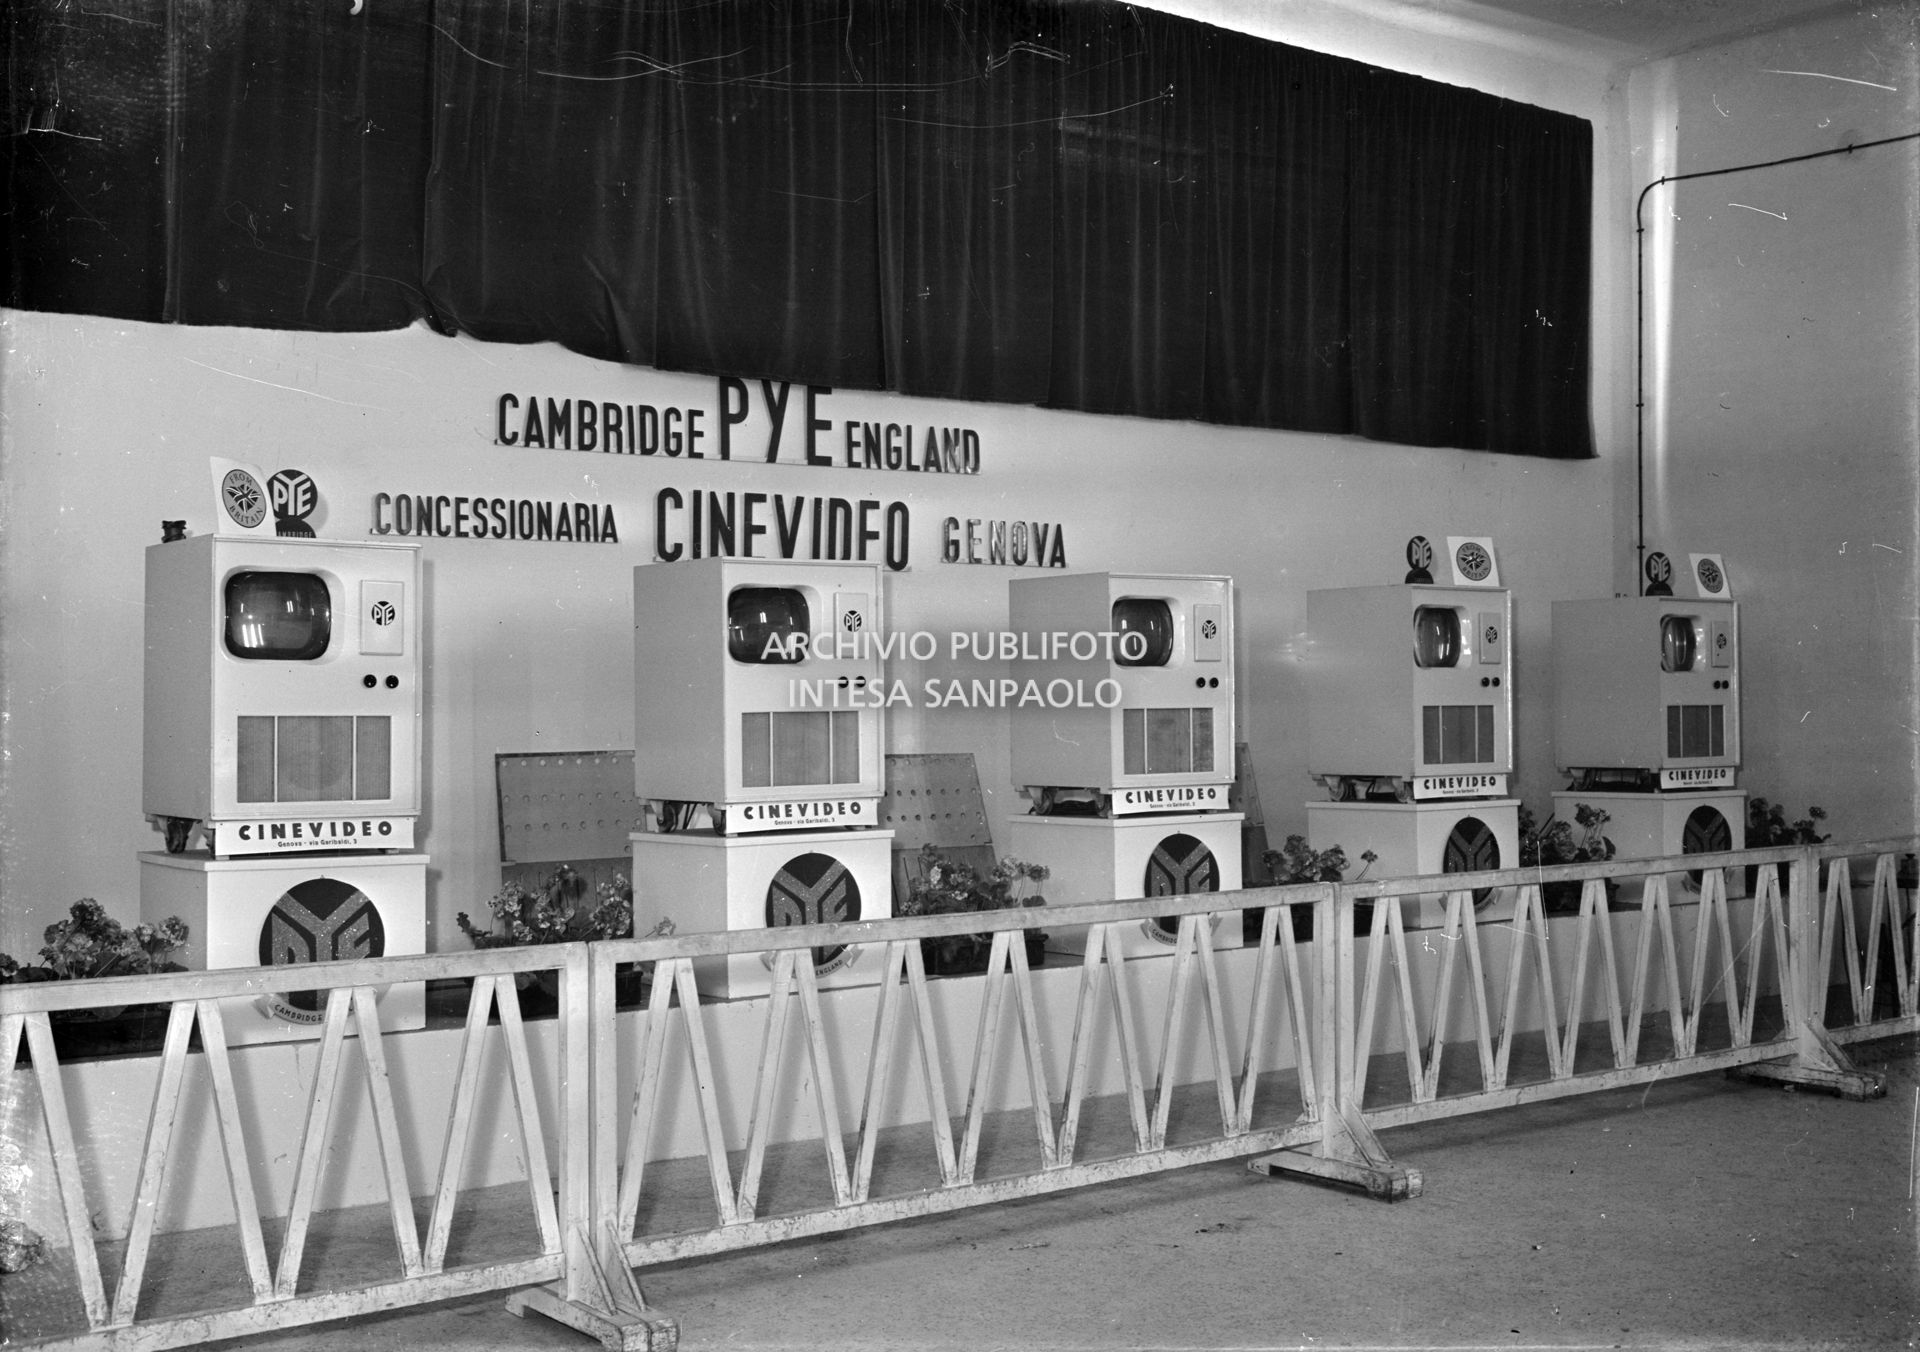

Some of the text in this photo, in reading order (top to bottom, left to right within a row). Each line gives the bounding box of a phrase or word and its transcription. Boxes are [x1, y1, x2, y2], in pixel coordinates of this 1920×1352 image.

[499, 376, 981, 475] CAMBRIDGE PYE ENGLAND
[229, 472, 253, 486] FROM
[273, 472, 312, 517] PYE
[229, 505, 263, 525] BRITAIN
[374, 492, 619, 544] CONCESSIONARIA
[944, 516, 1066, 568] GENOVA
[1411, 537, 1431, 569] PYE
[1651, 554, 1670, 582] PYE
[372, 601, 395, 626] PYE
[844, 610, 862, 632] PYE
[1424, 776, 1496, 790] CINEVIDEO
[1669, 769, 1727, 781] CINEVIDEO
[1126, 788, 1216, 804] CINEVIDEO
[744, 801, 861, 820] CINEVIDEO
[239, 821, 392, 841] CINEVIDEO
[274, 1004, 323, 1022] CAMBRIDGE
